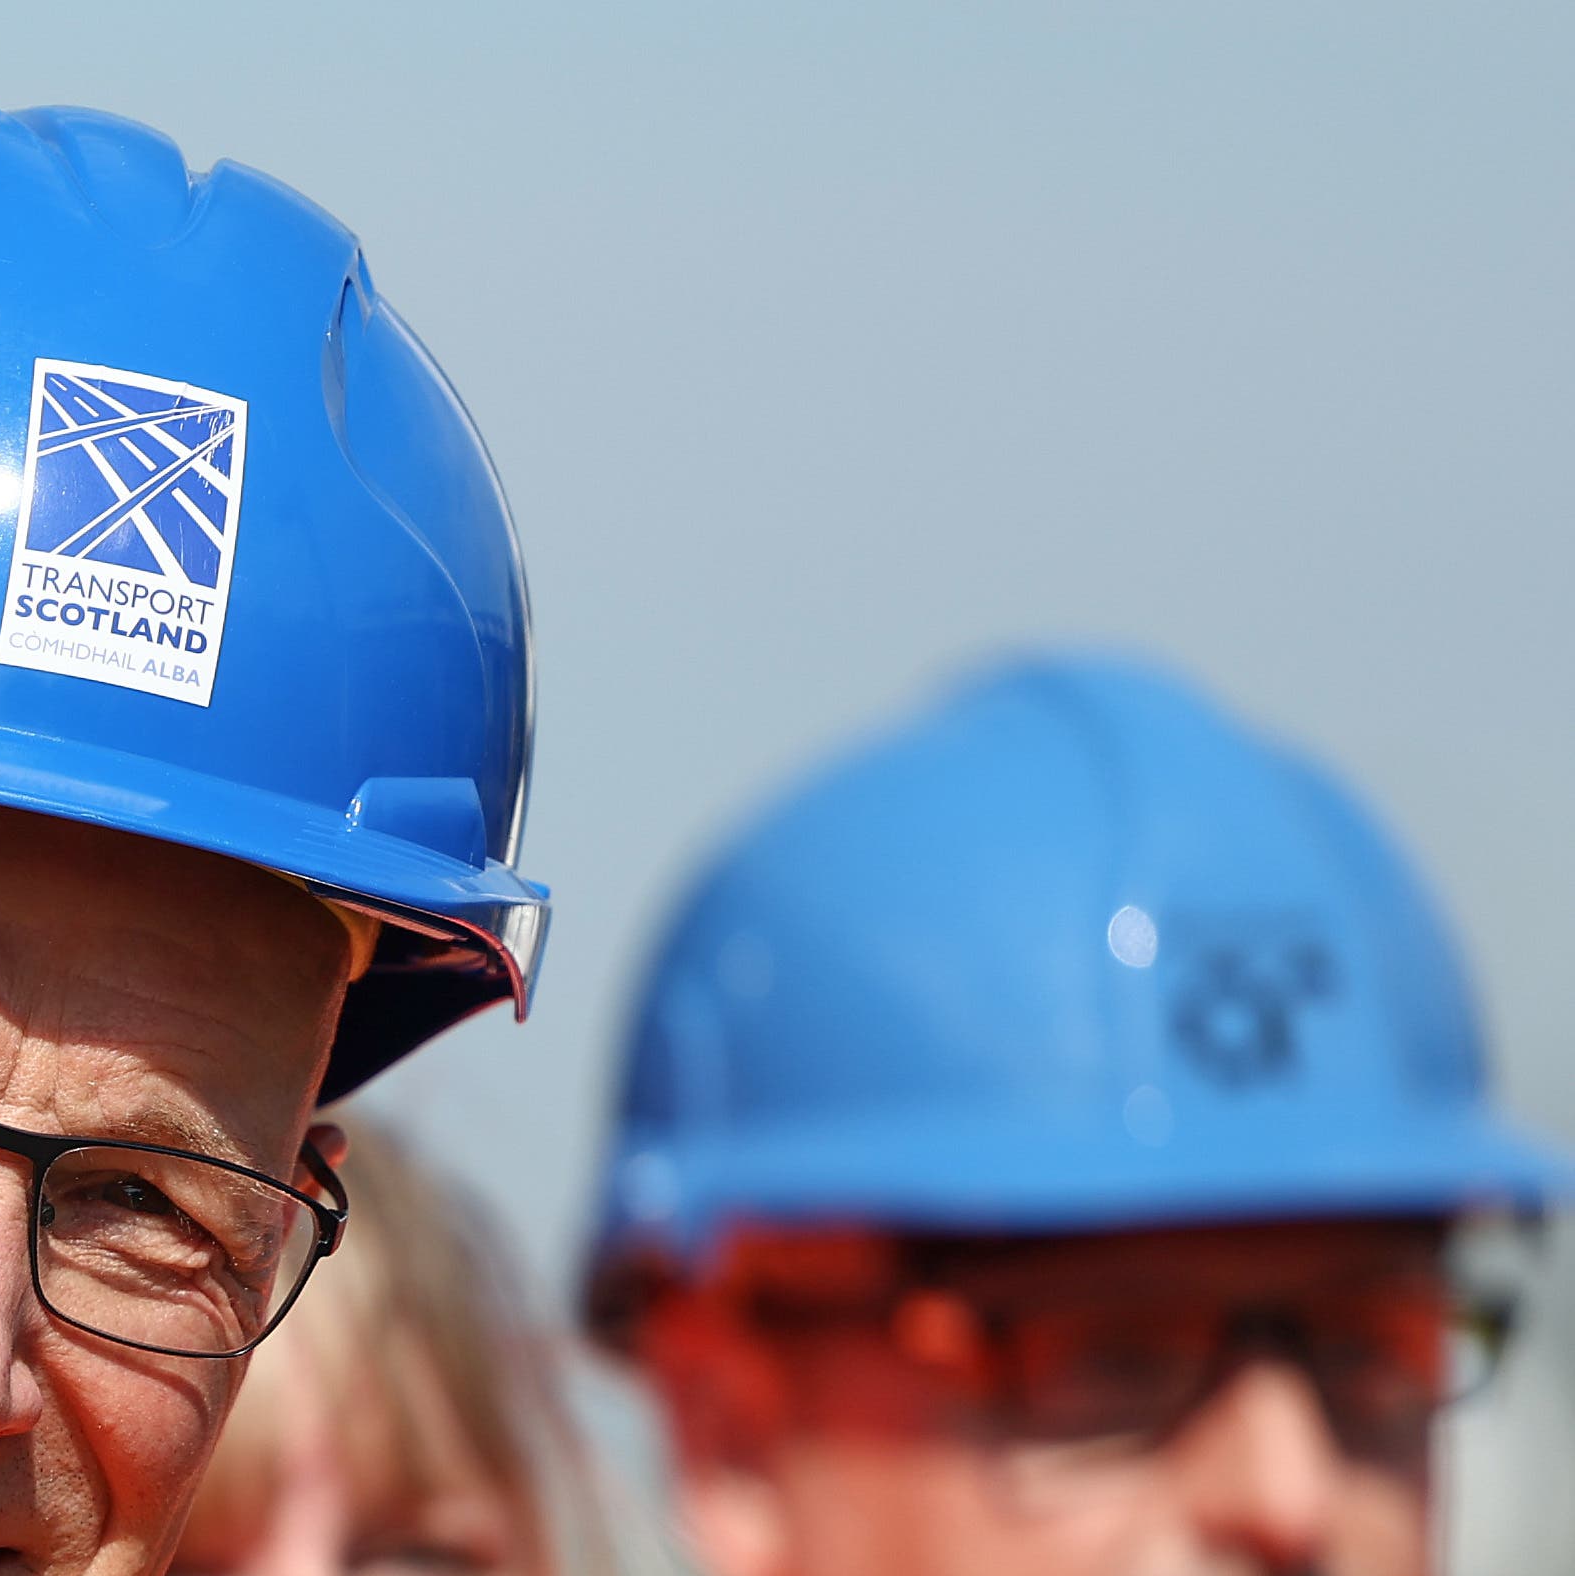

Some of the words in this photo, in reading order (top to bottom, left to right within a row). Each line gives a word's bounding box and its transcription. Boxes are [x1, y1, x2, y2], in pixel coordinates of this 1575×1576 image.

[21, 562, 215, 625] TRANSPORT
[15, 594, 208, 655] SCOTLAND
[9, 630, 137, 671] CÒMHDHAIL
[142, 658, 201, 687] ALBA
